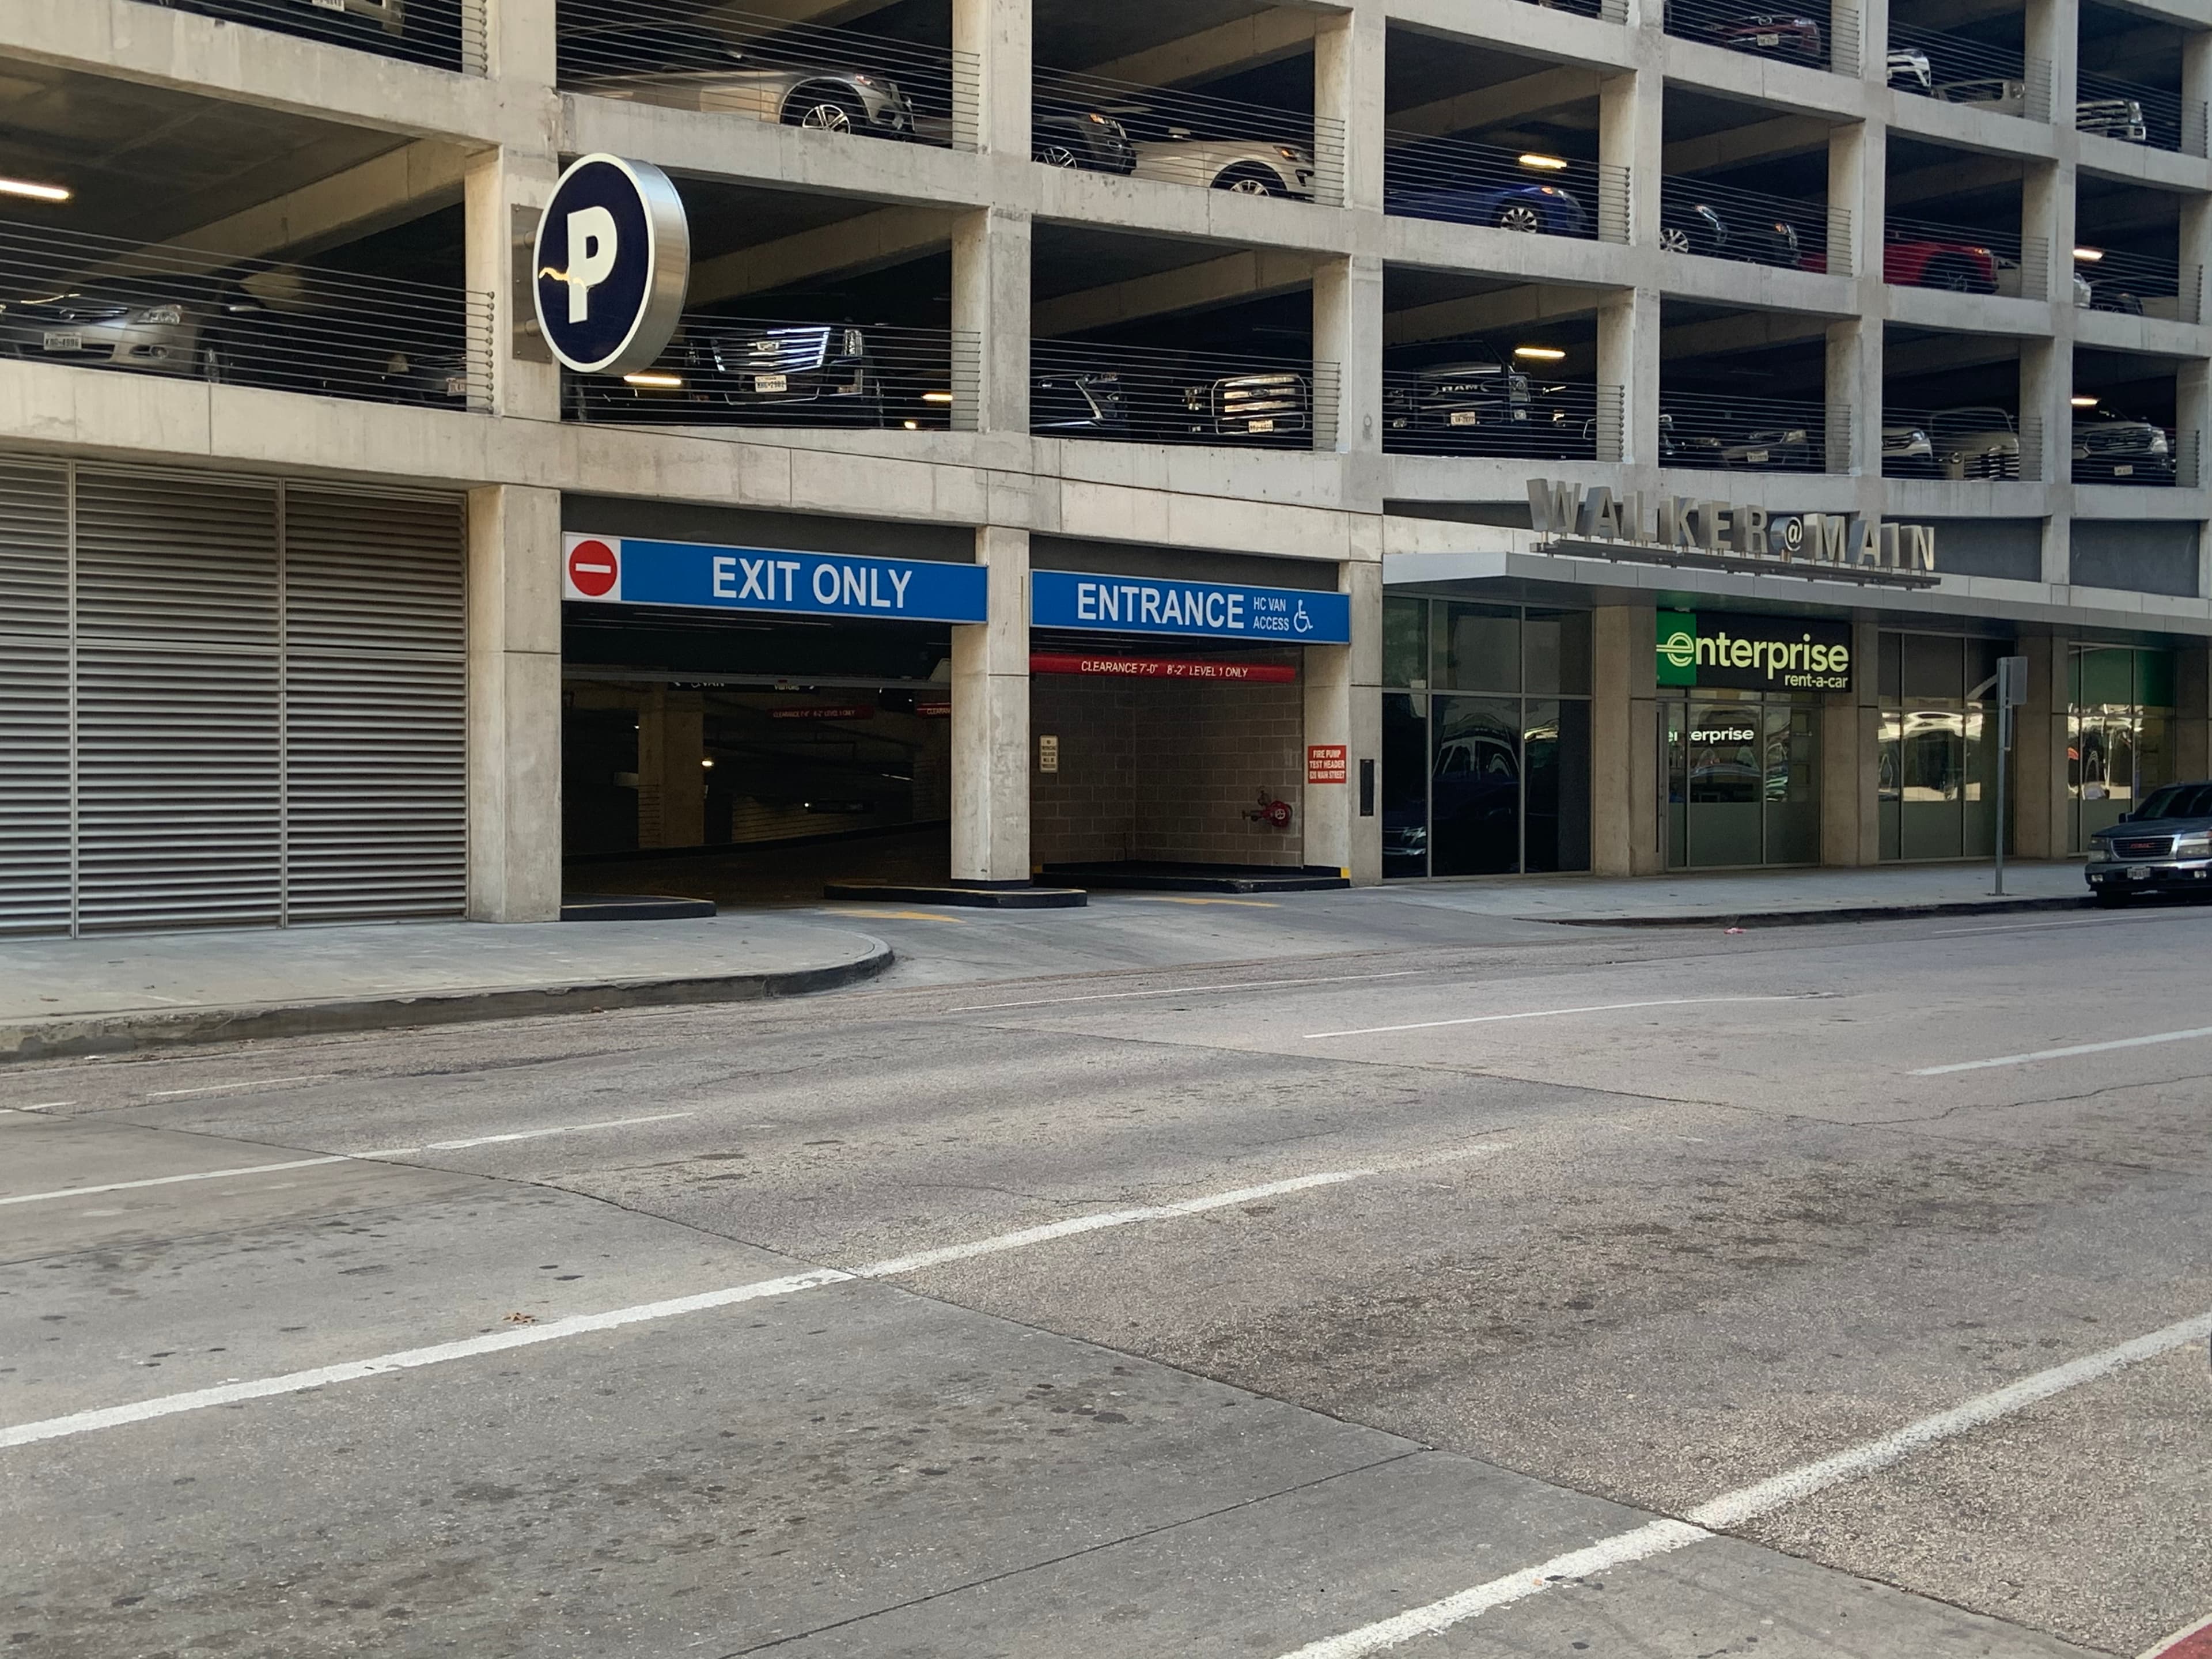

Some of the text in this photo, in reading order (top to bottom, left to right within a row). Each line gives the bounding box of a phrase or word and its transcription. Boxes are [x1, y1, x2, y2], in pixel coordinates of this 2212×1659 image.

[567, 206, 618, 324] P
[713, 556, 912, 609] EXIT ONLY
[1077, 582, 1245, 629] ENTRANCE
[1253, 596, 1286, 612] HC VAN
[1253, 616, 1290, 631] ACCESS
[1656, 631, 1849, 680] enterprise
[1081, 661, 1137, 673] CLEARANCE
[1189, 665, 1217, 677] LEVEL
[1219, 667, 1223, 676] 1
[1225, 666, 1248, 678] ONLY
[1785, 673, 1848, 688] rent-a-car
[1309, 760, 1345, 769] TEST HEADER
